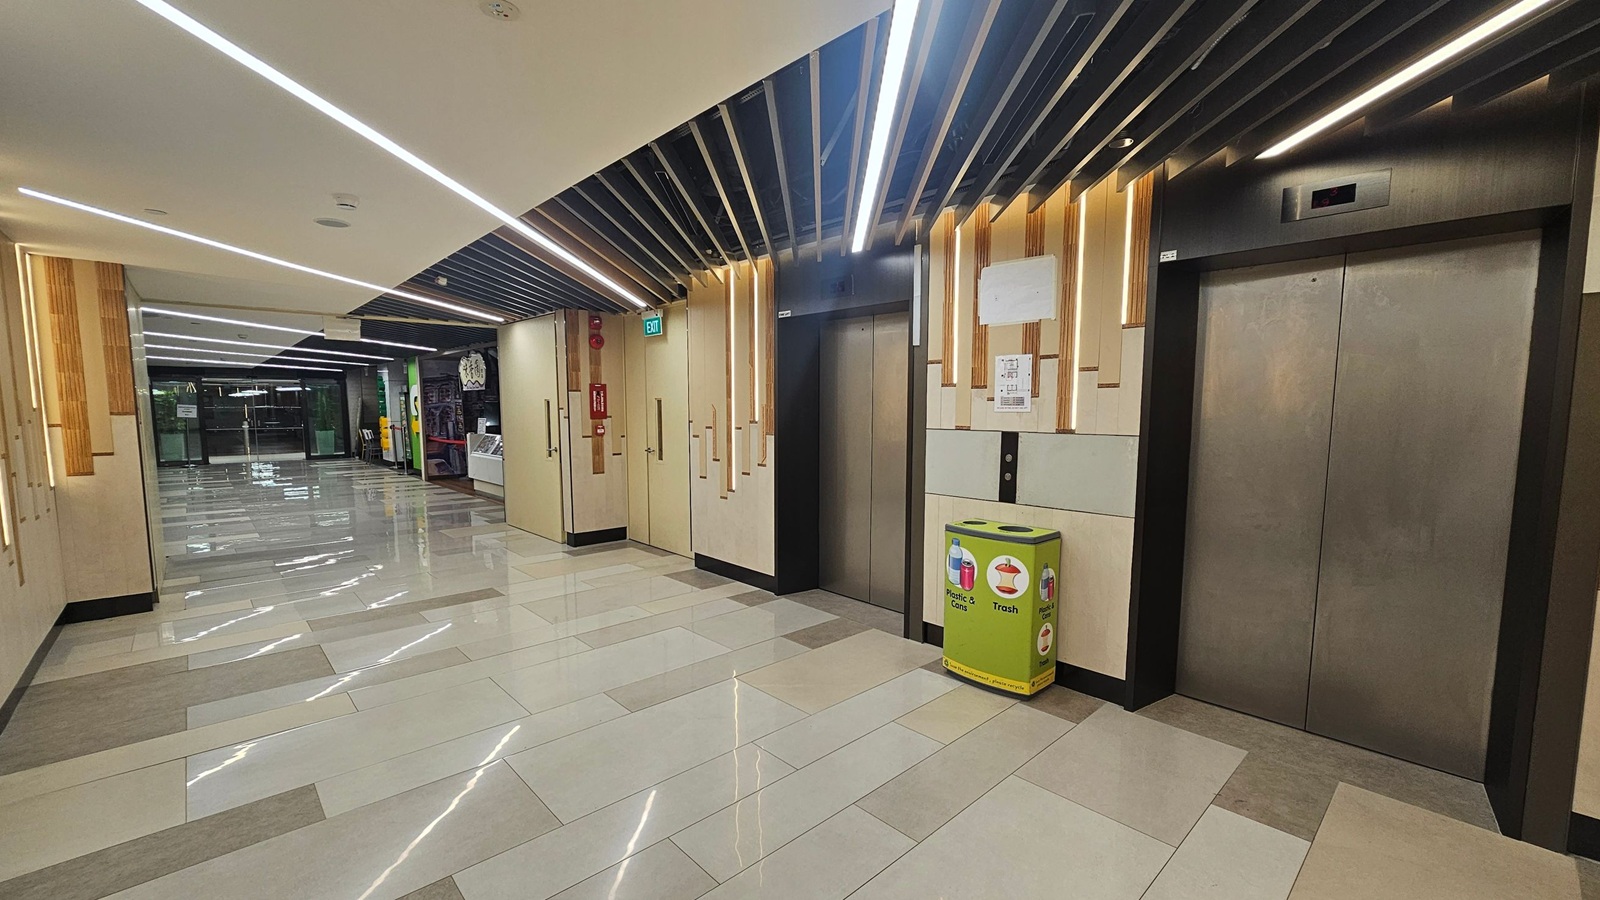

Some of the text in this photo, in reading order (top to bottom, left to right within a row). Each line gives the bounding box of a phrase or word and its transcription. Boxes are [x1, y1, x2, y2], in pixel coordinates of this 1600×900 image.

[646, 319, 659, 334] EXIT
[946, 589, 976, 605] Plastic &
[951, 600, 968, 612] Cans
[992, 601, 1019, 614] Trash
